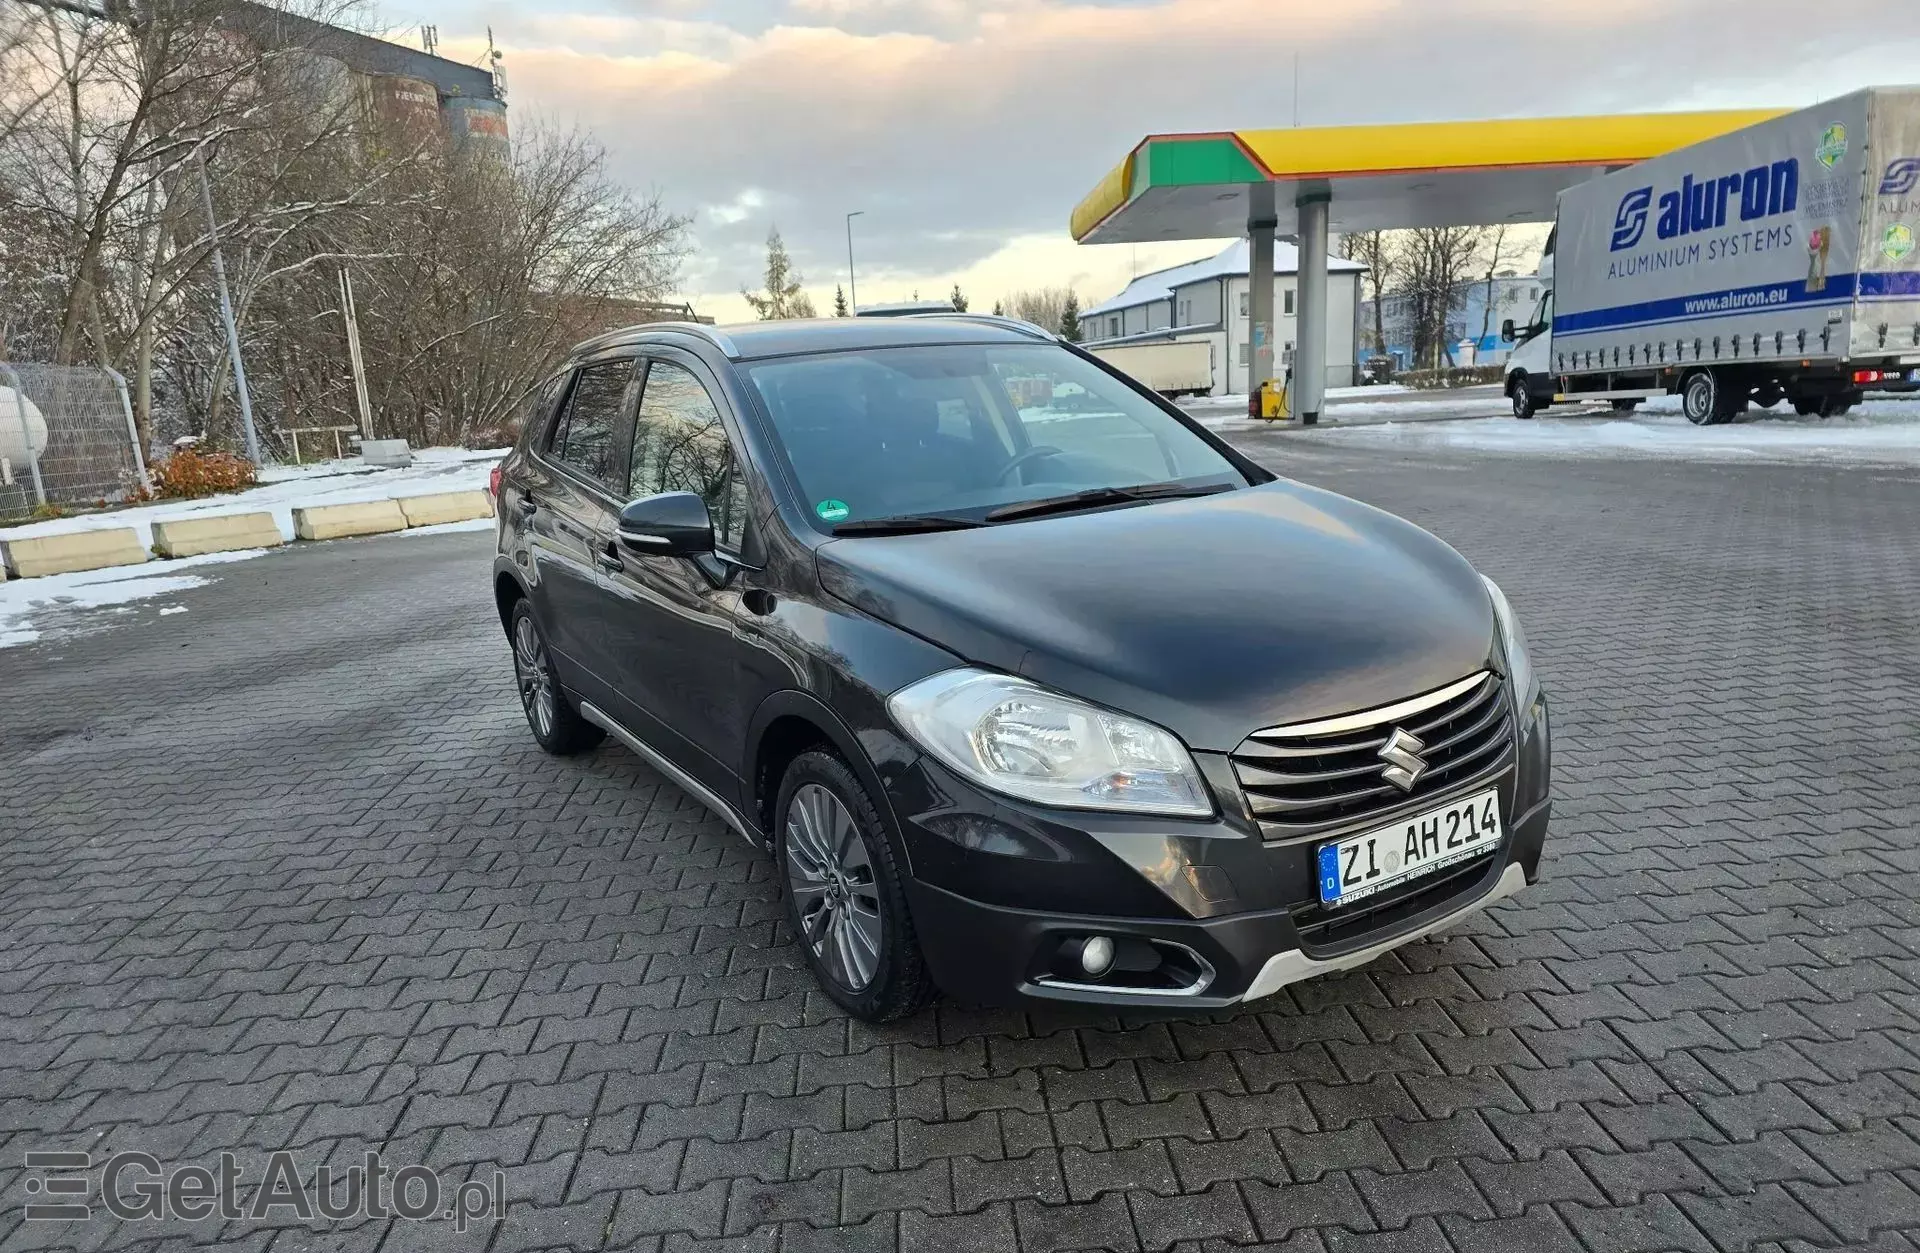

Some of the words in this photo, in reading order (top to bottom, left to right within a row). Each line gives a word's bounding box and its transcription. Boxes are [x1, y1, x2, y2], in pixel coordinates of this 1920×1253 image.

[1656, 157, 1798, 240] aluron
[1608, 243, 1700, 280] ALUMINIUM
[1708, 224, 1793, 261] SYSTEMS
[1684, 287, 1788, 314] www.aluron.eu
[1327, 877, 1335, 890] D
[1340, 838, 1381, 887] ZI
[1342, 885, 1376, 905] SUZUKI
[1407, 863, 1436, 881] HEINRICH
